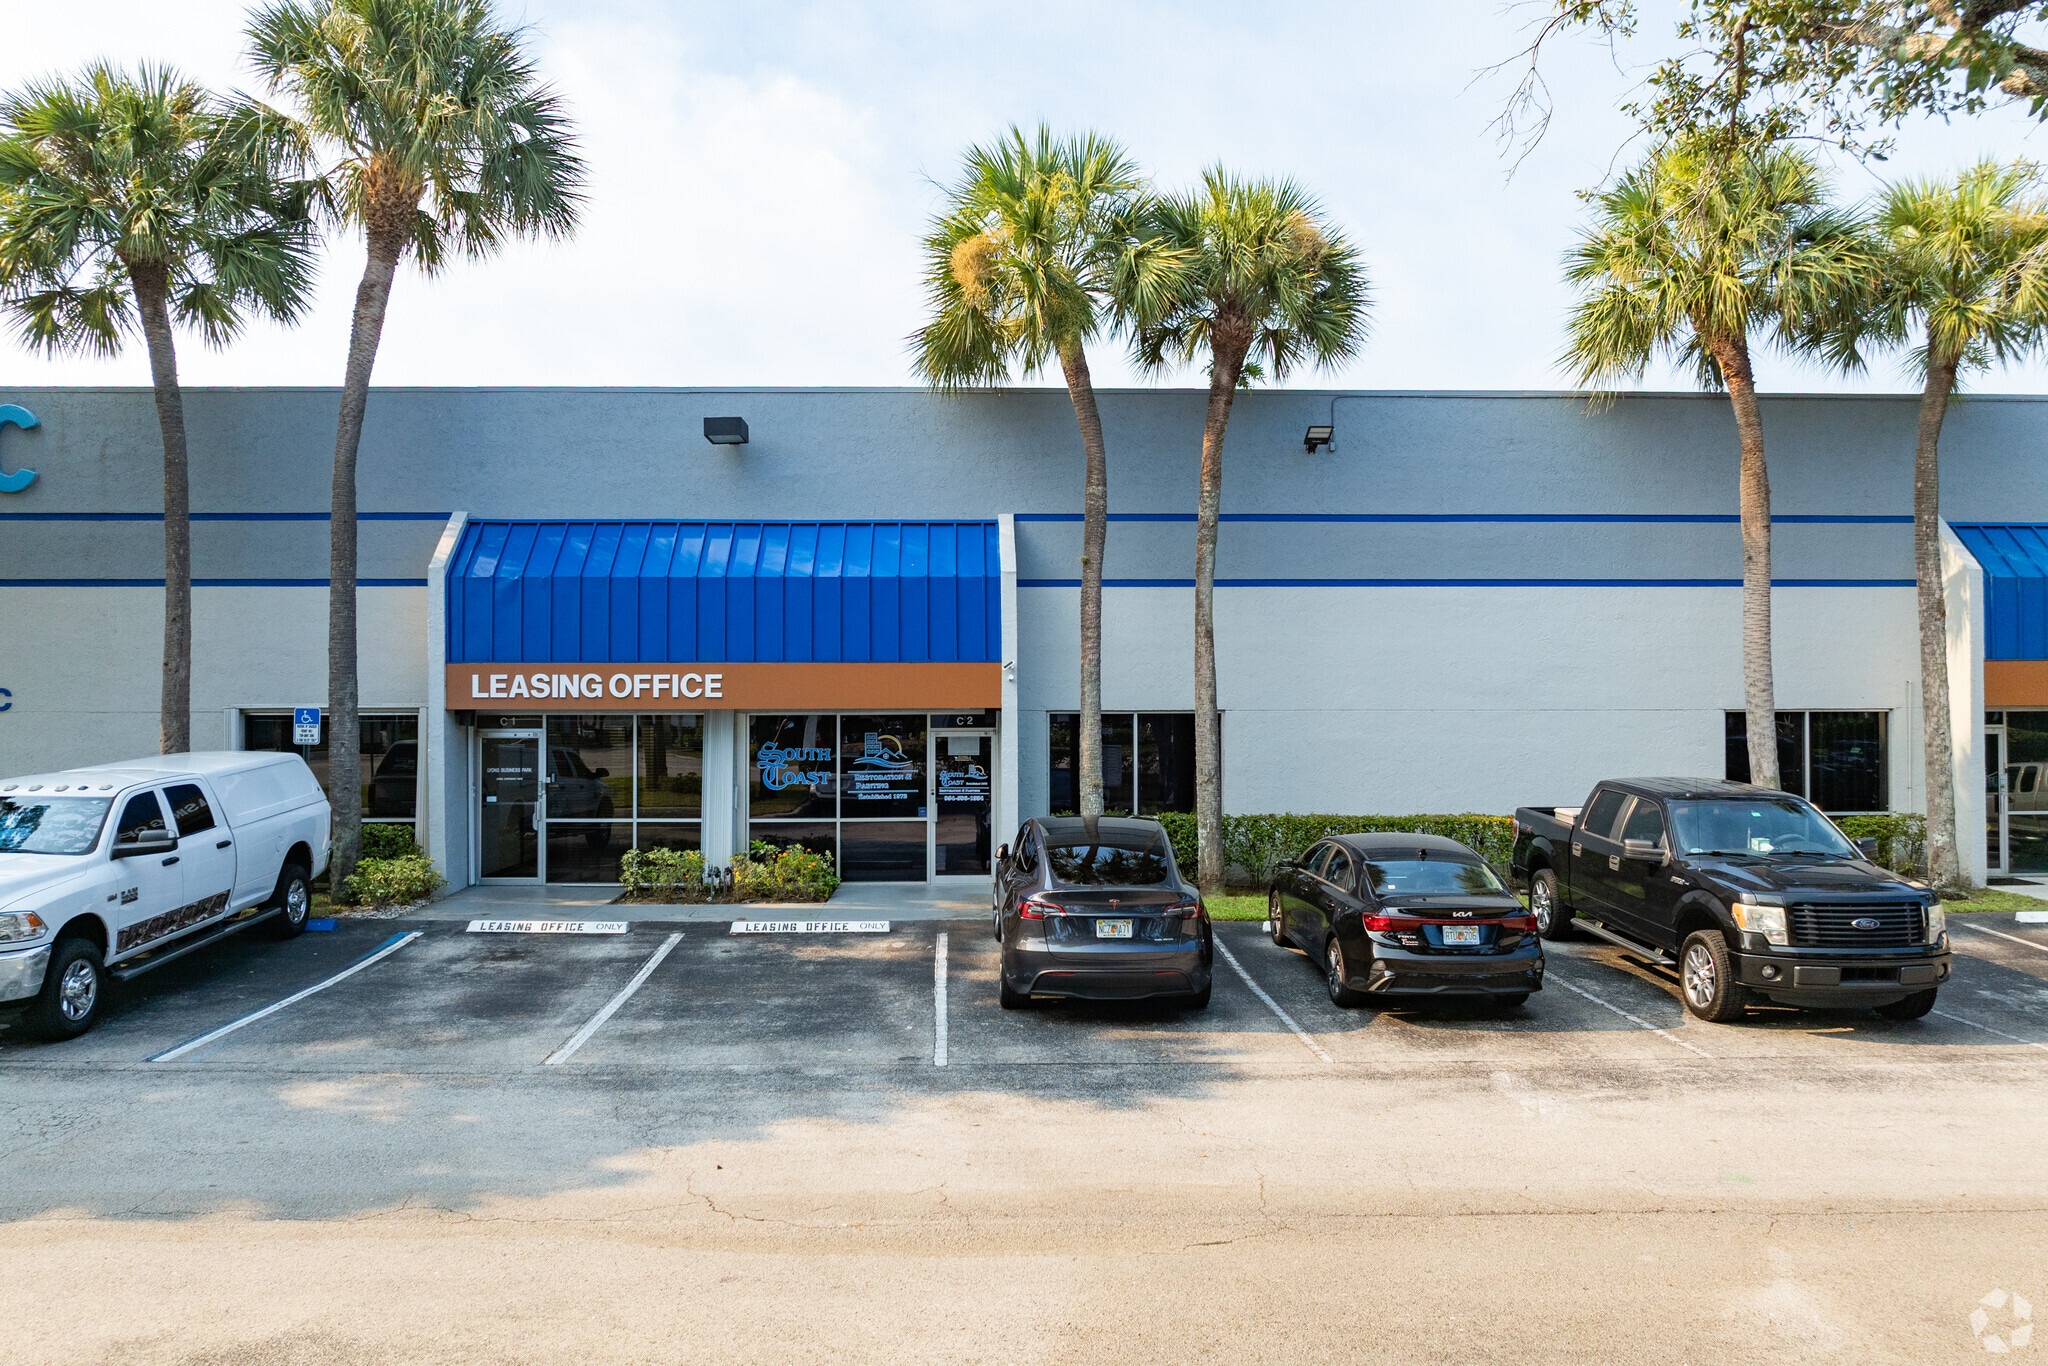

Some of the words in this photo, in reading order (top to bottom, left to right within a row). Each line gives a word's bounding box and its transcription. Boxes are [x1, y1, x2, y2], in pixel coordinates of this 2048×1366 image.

[471, 673, 603, 699] LEASING
[608, 673, 723, 699] OFFICE
[956, 716, 964, 726] C
[966, 716, 974, 725] 2
[757, 741, 831, 765] SOUTH
[757, 760, 832, 790] COAST
[855, 782, 890, 790] PAINTING
[480, 922, 533, 931] LEASING
[540, 922, 585, 932] OFFICE
[595, 923, 624, 931] ONLY
[745, 922, 797, 932] LEASING
[806, 922, 849, 931] OFFICE
[859, 922, 886, 930] ONLY
